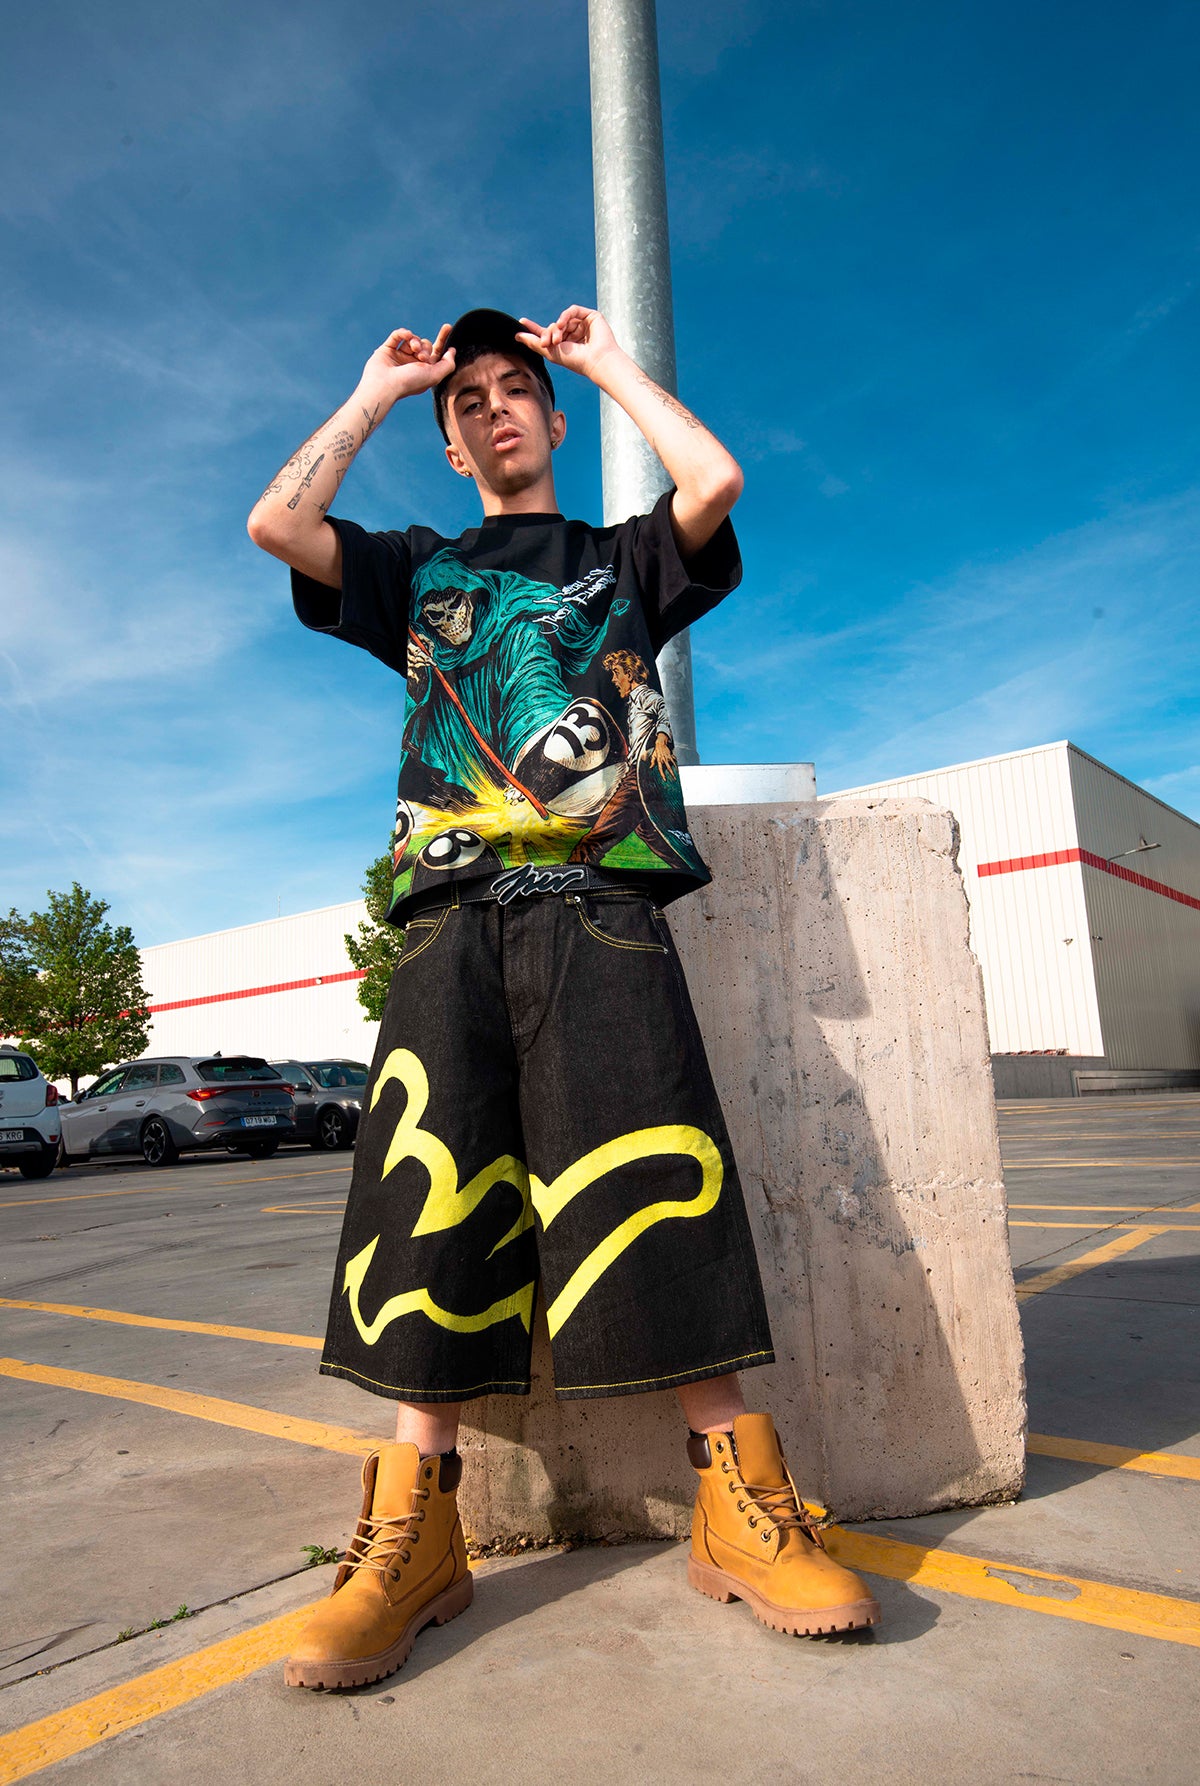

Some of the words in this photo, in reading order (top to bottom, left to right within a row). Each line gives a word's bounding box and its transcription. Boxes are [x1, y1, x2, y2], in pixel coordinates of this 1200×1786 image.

[553, 705, 608, 760] 13
[422, 829, 481, 866] 8
[6, 1131, 22, 1140] KRG
